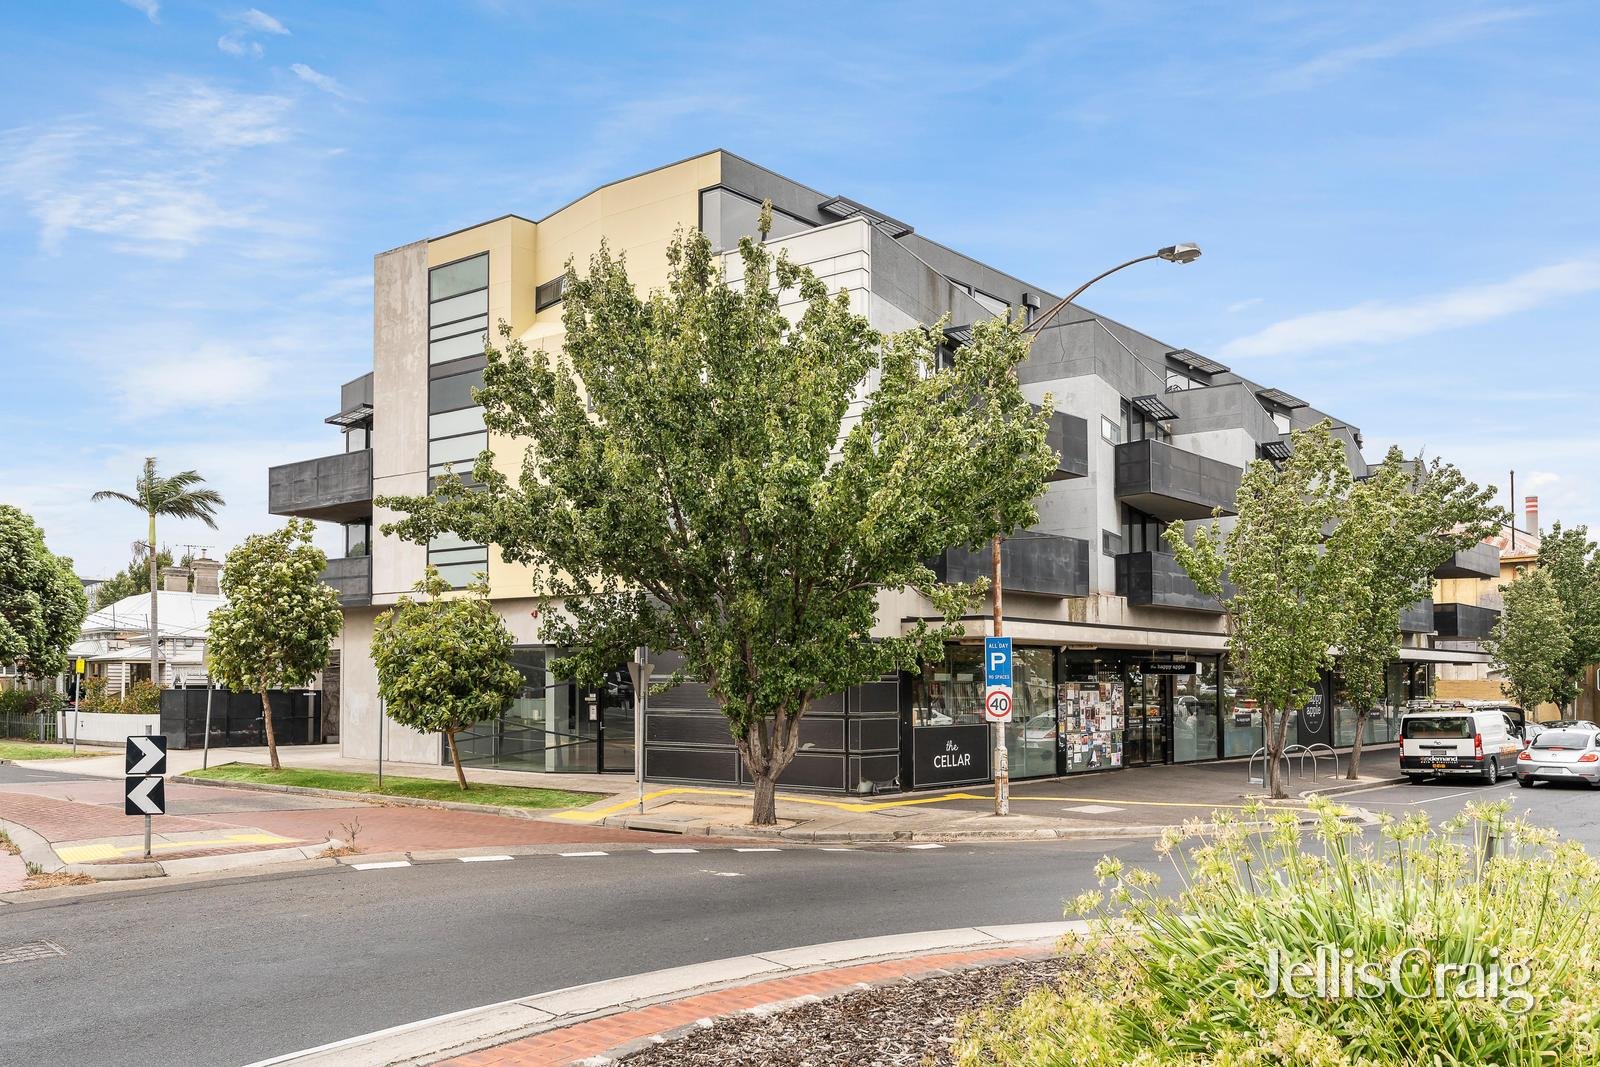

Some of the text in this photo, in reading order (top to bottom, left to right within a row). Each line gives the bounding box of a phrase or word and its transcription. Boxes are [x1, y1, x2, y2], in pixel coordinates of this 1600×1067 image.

[991, 652, 1007, 671] P
[990, 697, 1008, 711] 40
[1306, 704, 1321, 717] apple
[945, 739, 959, 751] the
[933, 753, 971, 768] CELLAR
